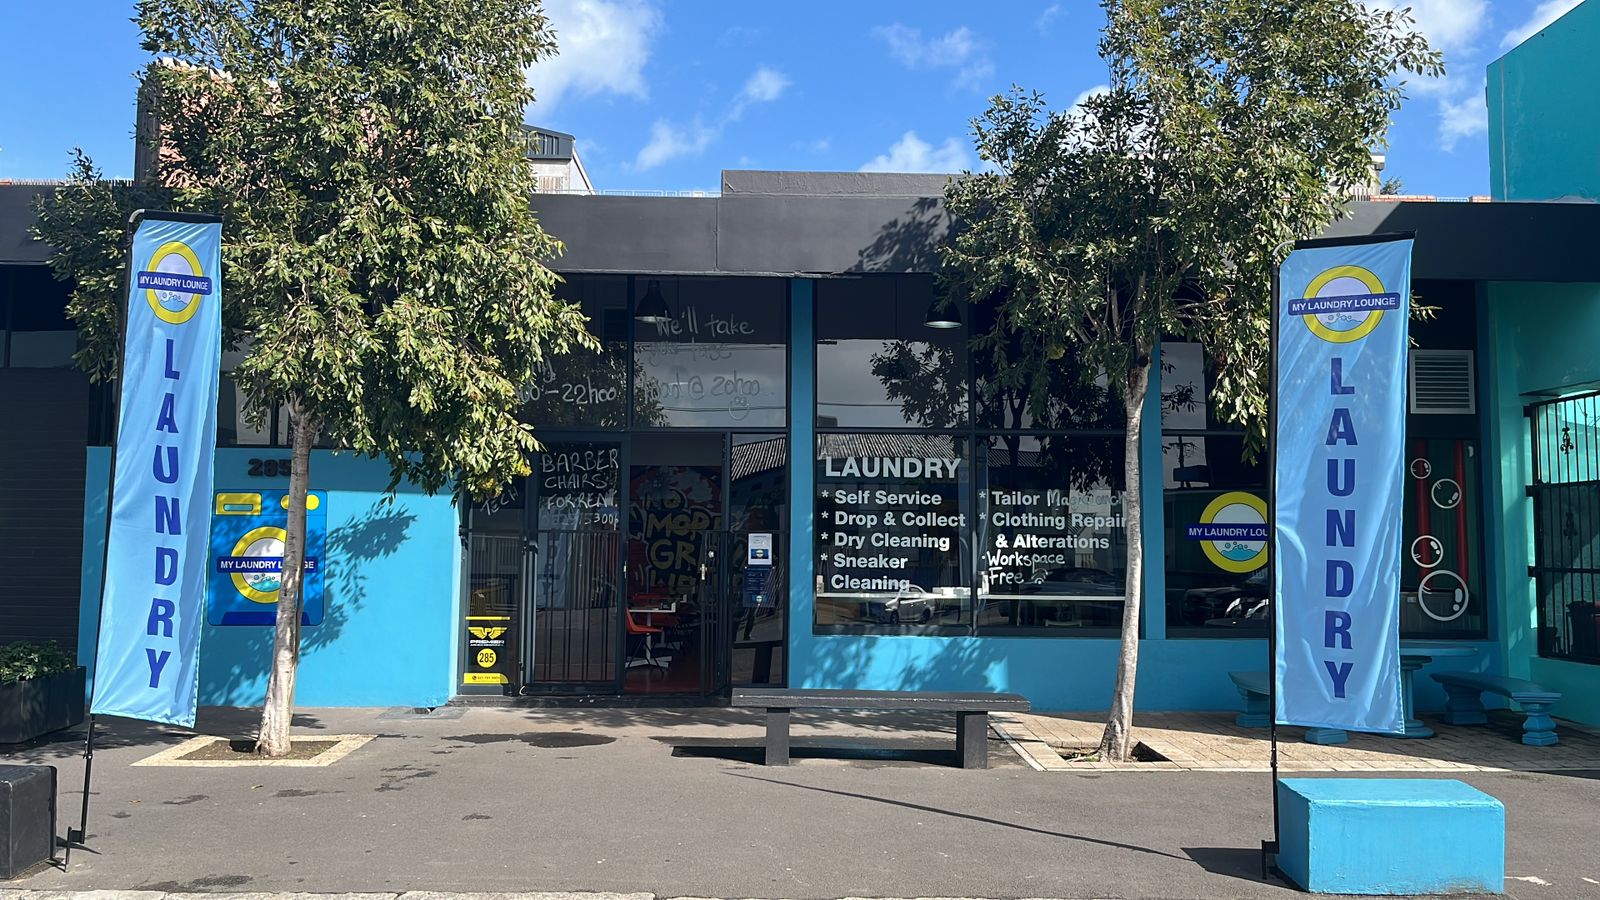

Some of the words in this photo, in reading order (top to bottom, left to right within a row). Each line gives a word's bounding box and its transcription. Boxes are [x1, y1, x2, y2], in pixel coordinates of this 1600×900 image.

[139, 275, 150, 284] MY
[150, 277, 182, 288] LAUNDRY
[182, 279, 208, 290] LOUNGE
[1292, 302, 1308, 312] MY
[1308, 299, 1353, 310] LAUNDRY
[1354, 297, 1396, 308] LOUNGE
[654, 304, 699, 337] We'll
[704, 313, 755, 338] take
[541, 448, 620, 473] BARBER
[825, 456, 962, 479] LAUNDRY
[544, 473, 608, 490] CHAIRS
[547, 493, 576, 511] FOR
[834, 490, 871, 505] Self
[875, 490, 943, 506] Service
[991, 490, 1041, 506] Tailor
[145, 338, 182, 689] LAUNDRY
[835, 511, 878, 529] Drop
[883, 511, 897, 526] &
[901, 511, 966, 528] Collect
[991, 512, 1066, 530] Clothing
[1188, 528, 1204, 536] MY
[1204, 528, 1249, 536] LAUNDRY
[1323, 357, 1358, 698] LAUNDRY
[834, 532, 866, 550] Dry
[870, 533, 950, 552] Cleaning
[995, 533, 1009, 549] &
[1012, 533, 1110, 550] Alterations
[220, 560, 234, 569] MY
[235, 560, 277, 569] LAUNDRY
[833, 553, 909, 569] Sneaker
[986, 549, 1066, 574] Workspace
[831, 574, 910, 592] Cleaning
[988, 567, 1025, 586] Free
[479, 652, 494, 663] 285
